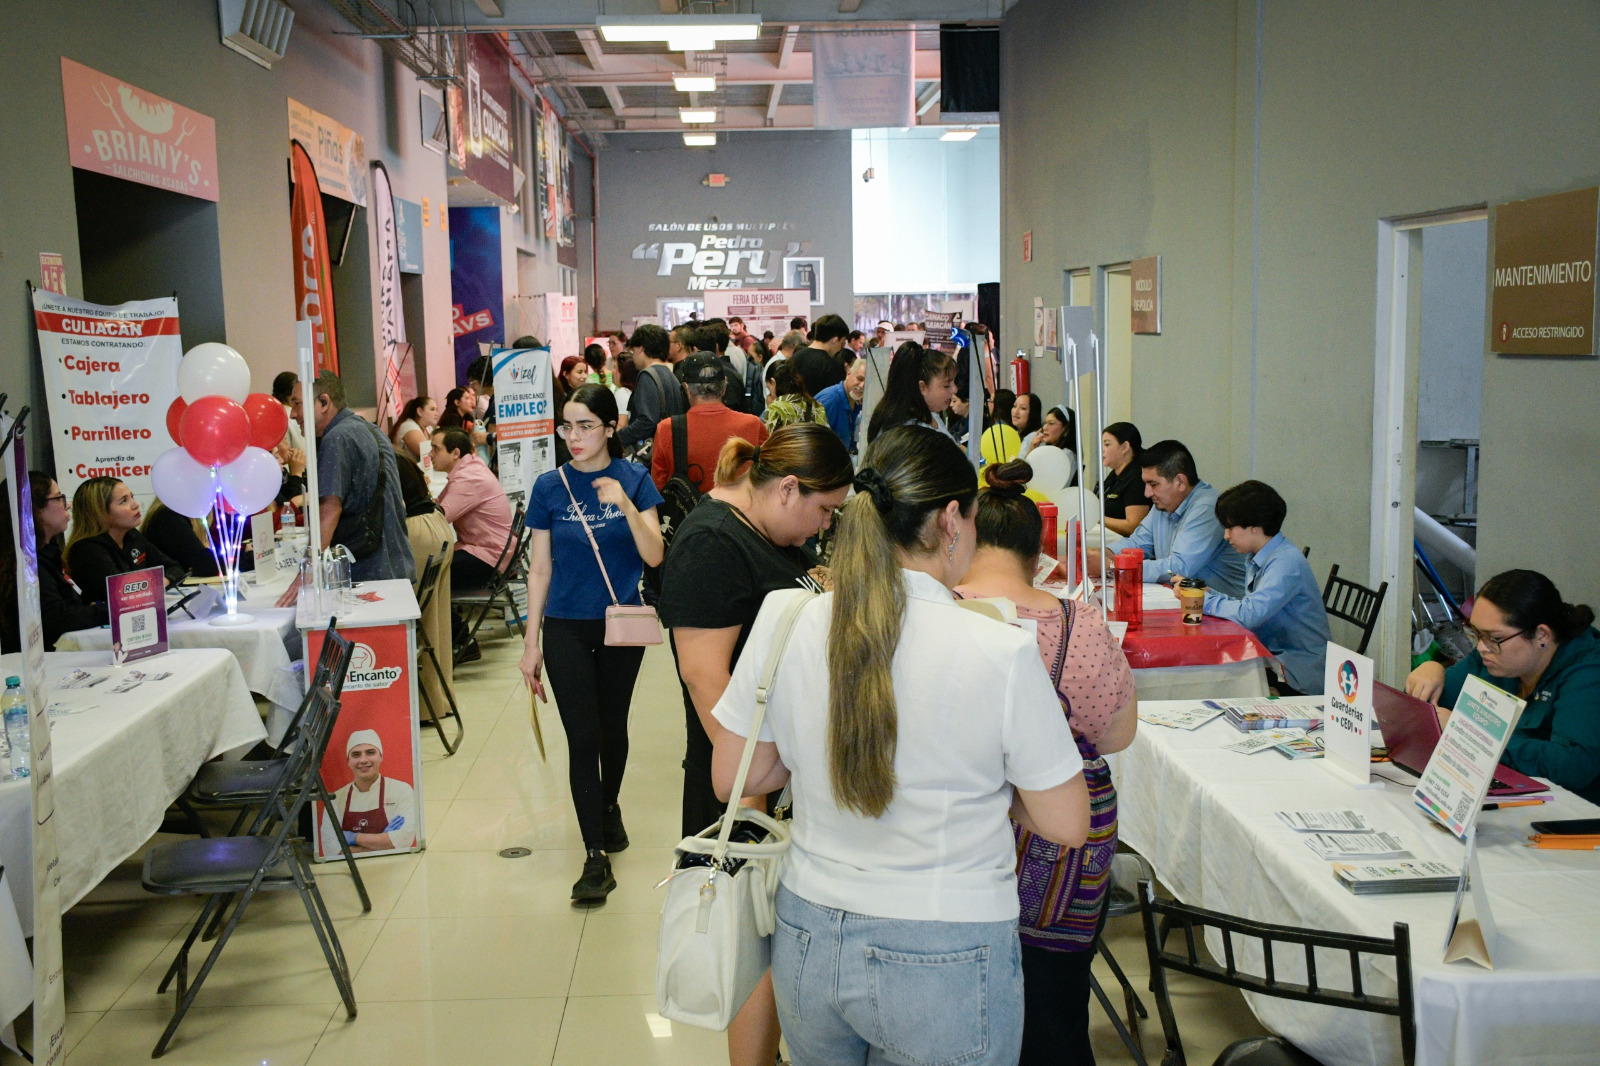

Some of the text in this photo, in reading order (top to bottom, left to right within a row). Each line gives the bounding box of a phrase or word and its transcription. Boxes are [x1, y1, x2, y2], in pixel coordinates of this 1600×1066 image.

[92, 130, 202, 185] BRIANY'S
[113, 164, 189, 192] SALCHICHAS ASADAS
[648, 222, 685, 231] SALÓN
[704, 223, 733, 231] USOS
[700, 235, 763, 249] Pedro
[1495, 261, 1592, 287] MANTENIMIENTO
[687, 276, 742, 290] Meza
[733, 293, 784, 305] FERIA DE EMPLEO
[67, 307, 94, 316] NUESTRO
[95, 310, 117, 318] EQUIPO
[1512, 326, 1584, 339] ACCESO RESTRINGIDO
[61, 338, 90, 347] ESTAMOS
[64, 355, 120, 375] Cajera
[68, 389, 150, 409] Tablajero
[498, 400, 547, 418] EMPLEO?
[72, 425, 152, 441] Parrillero
[76, 463, 153, 478] Carnicer
[124, 581, 148, 593] RETO
[1340, 717, 1353, 732] CEDI
